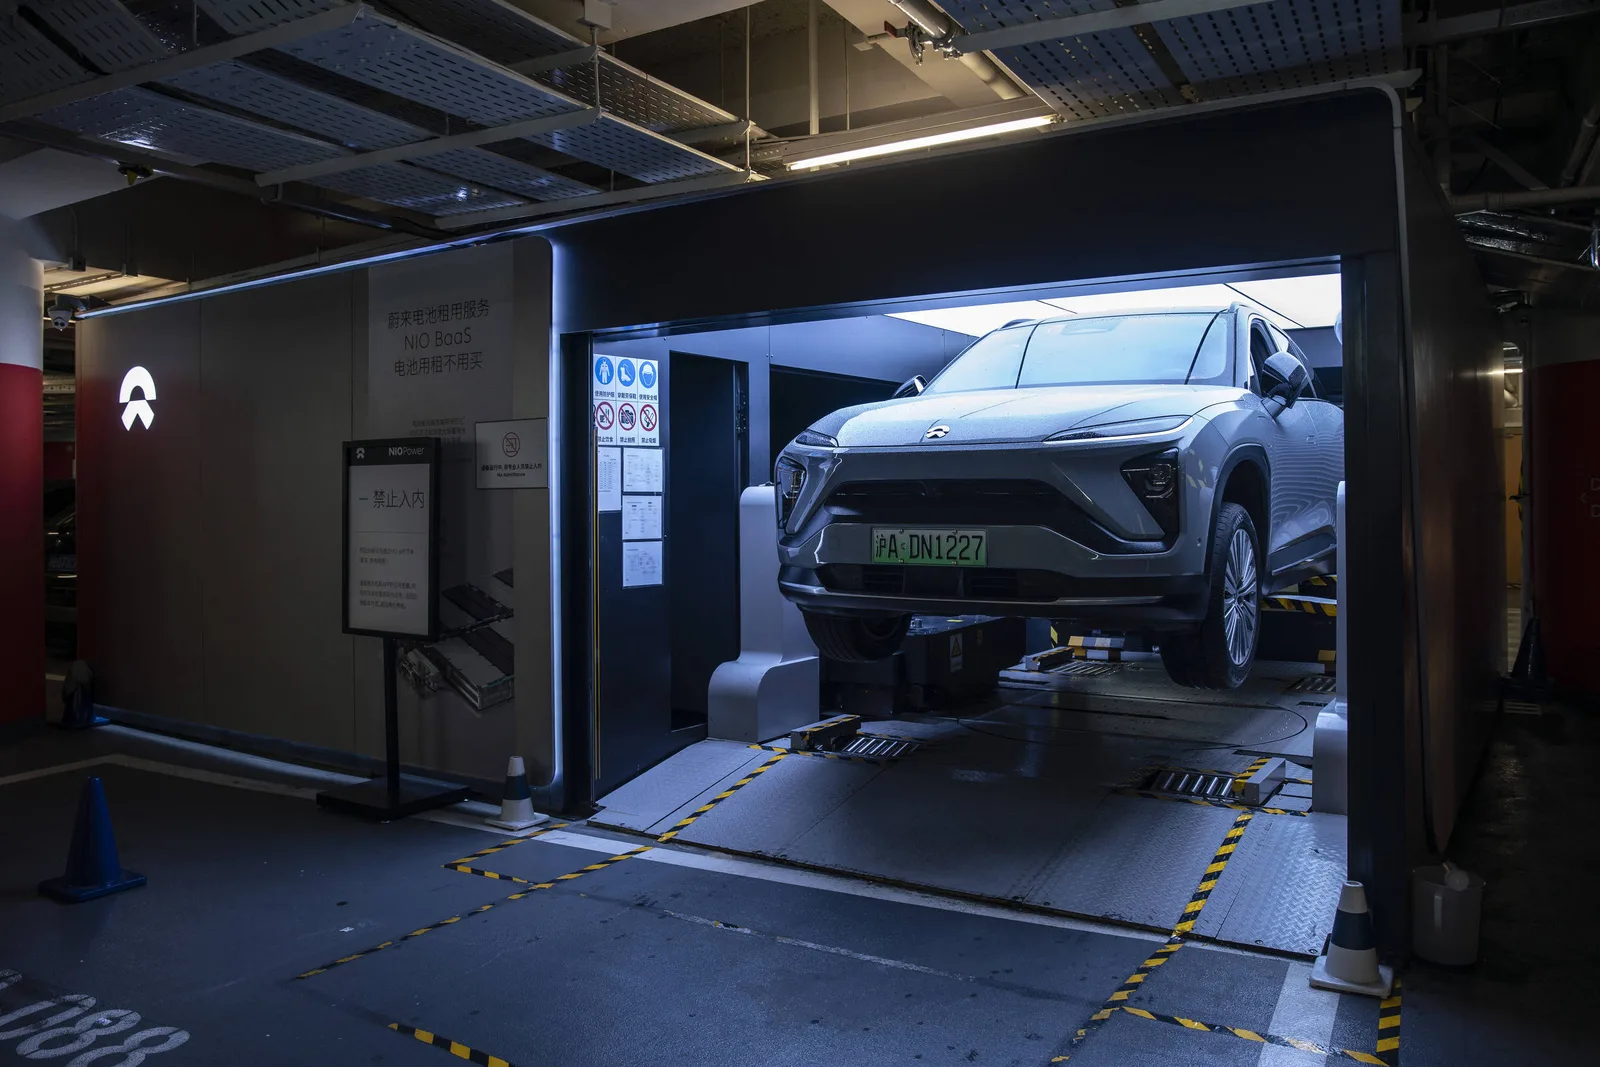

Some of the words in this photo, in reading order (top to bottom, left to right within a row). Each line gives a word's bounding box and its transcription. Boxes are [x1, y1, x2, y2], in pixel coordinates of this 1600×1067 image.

[387, 299, 490, 330] 蔚来电池租用服务
[404, 331, 430, 351] NIO
[435, 327, 472, 347] BaaS
[394, 351, 484, 377] 电池用租不用买
